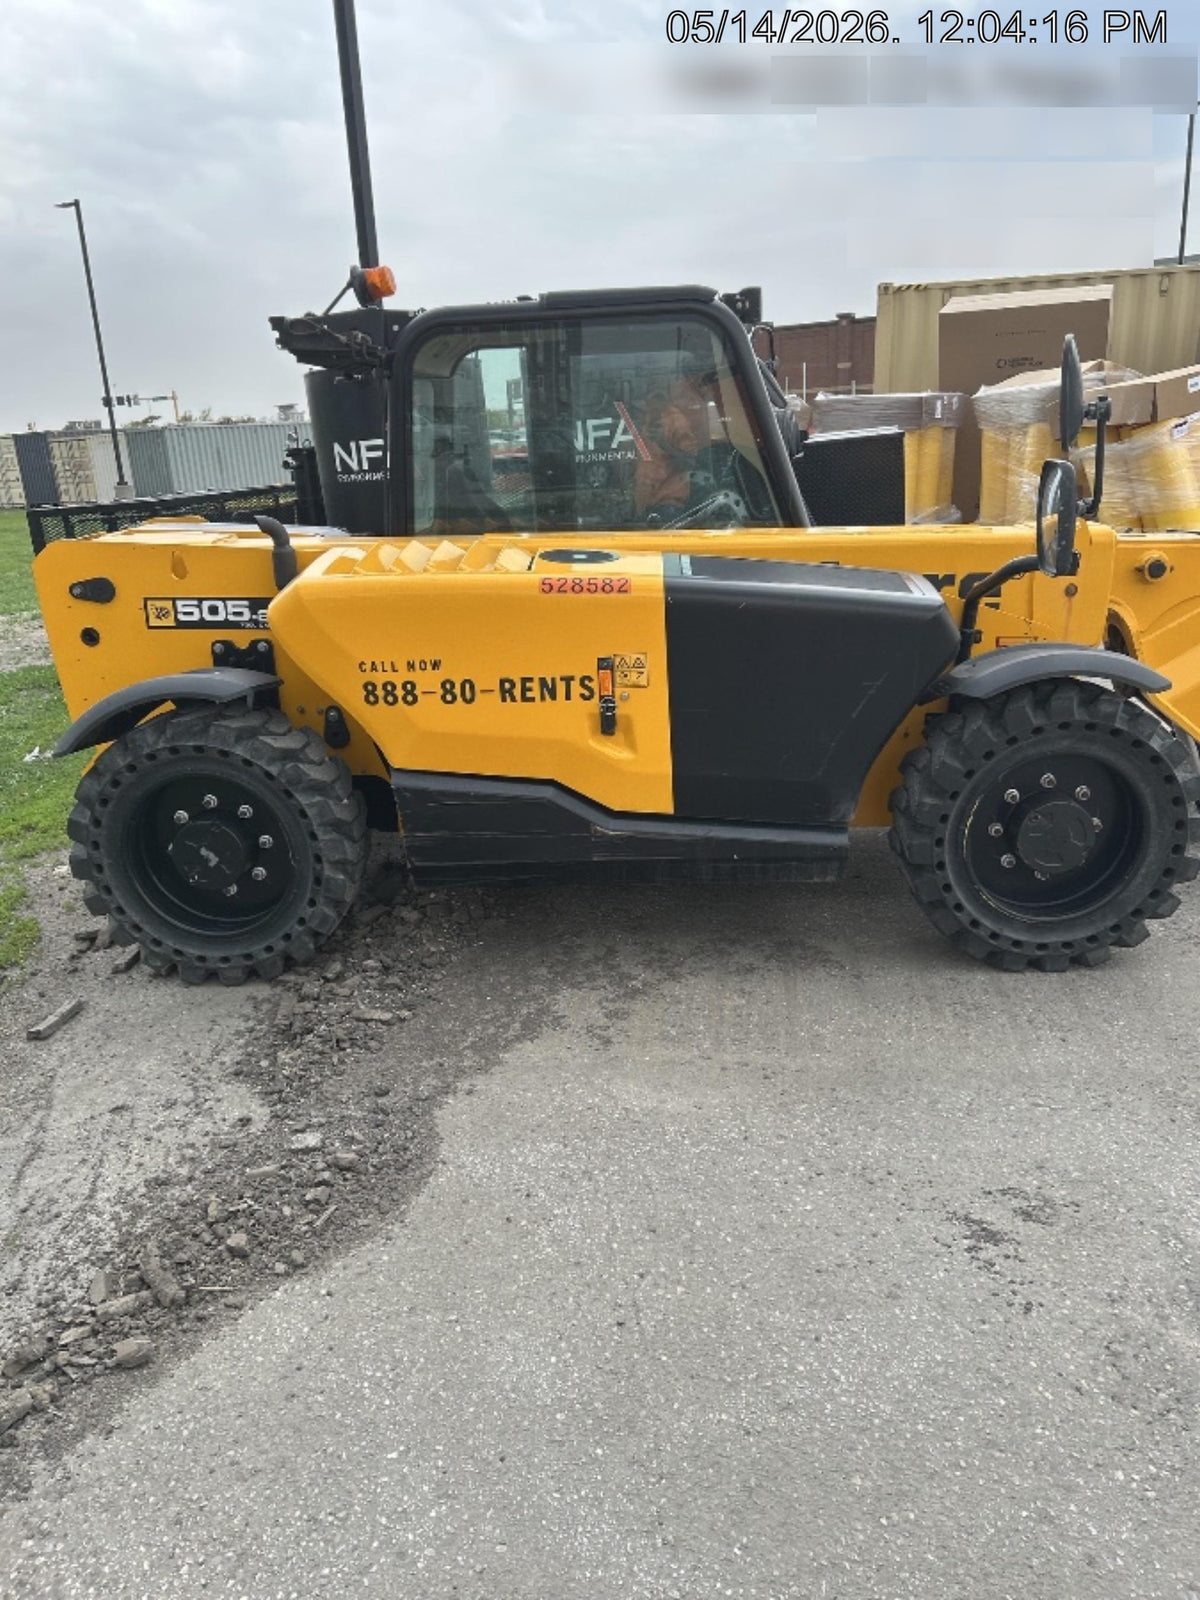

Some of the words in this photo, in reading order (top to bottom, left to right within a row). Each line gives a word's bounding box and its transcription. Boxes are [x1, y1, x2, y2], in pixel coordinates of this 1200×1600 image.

[333, 438, 390, 472] NF
[541, 577, 629, 594] 528582
[358, 660, 399, 673] CALL
[406, 658, 443, 672] NOW
[362, 674, 596, 706] 888-80-RENTS
